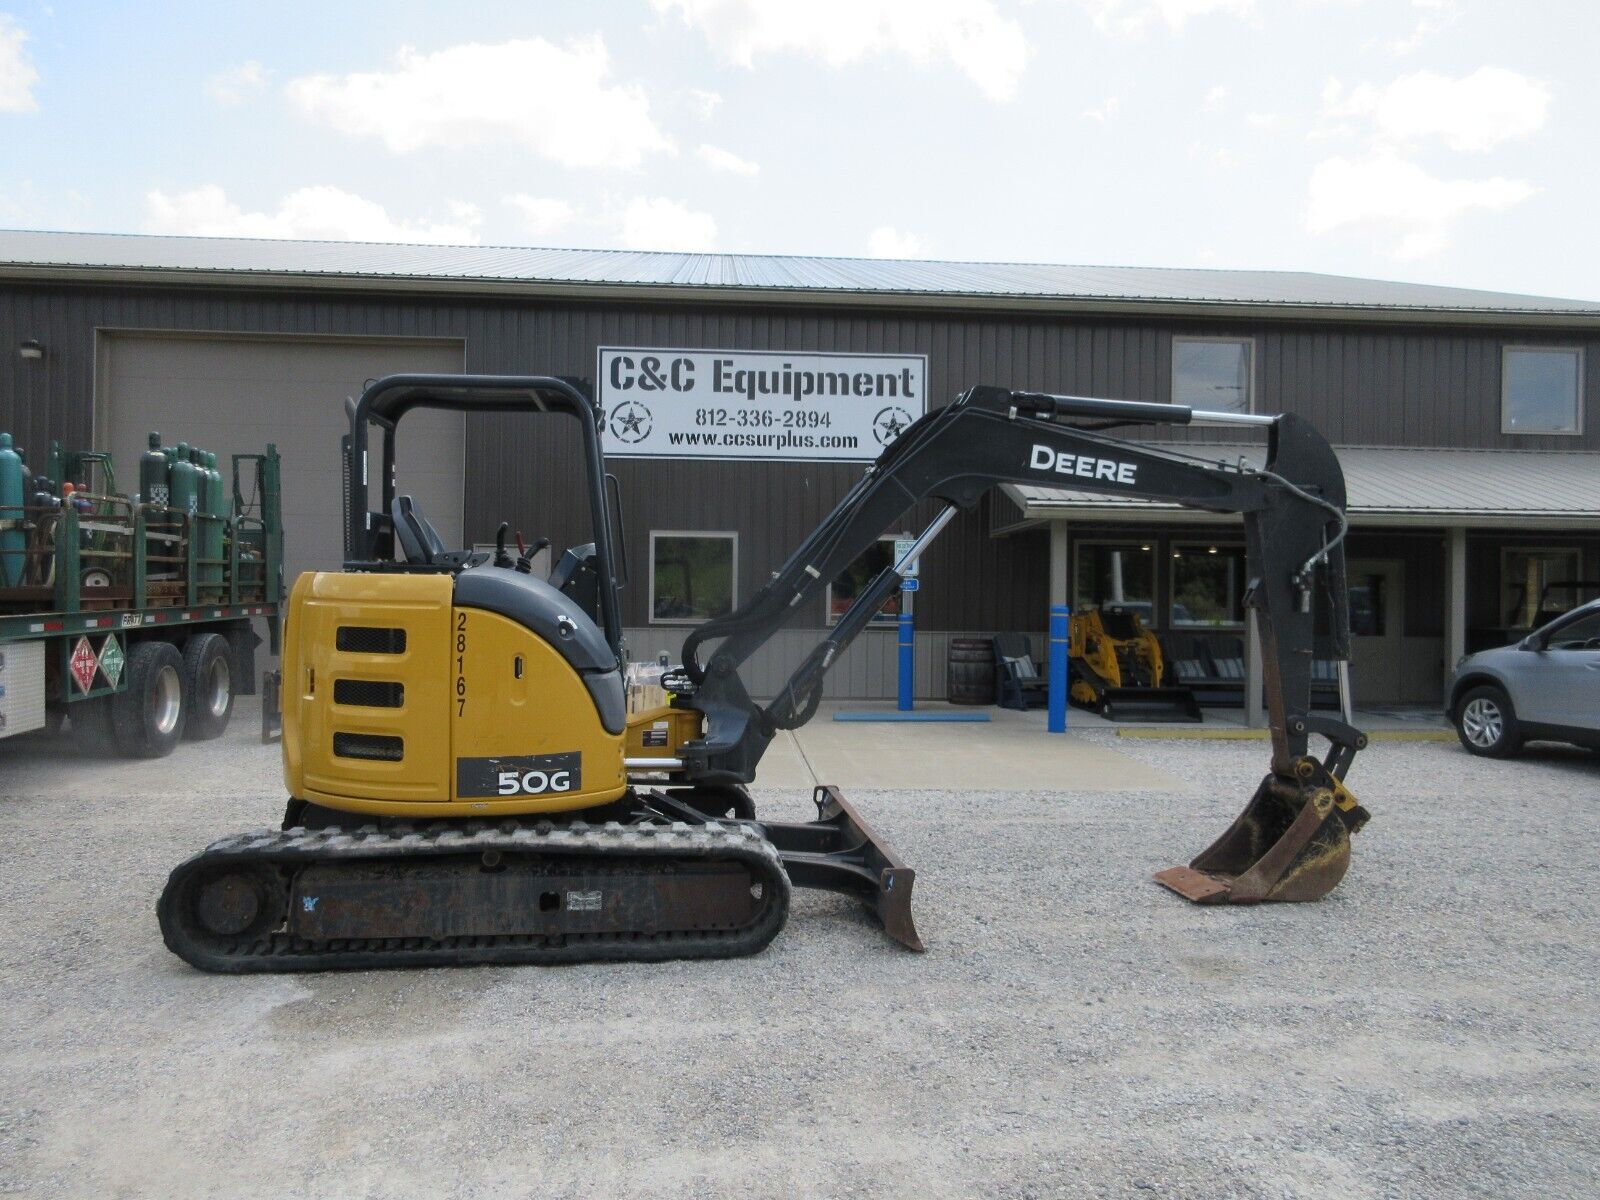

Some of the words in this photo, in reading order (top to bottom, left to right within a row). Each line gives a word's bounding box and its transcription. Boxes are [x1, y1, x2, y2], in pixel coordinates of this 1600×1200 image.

[610, 356, 695, 393] C&C
[713, 359, 915, 401] Equipment
[695, 408, 832, 428] 812-336-2894
[668, 430, 858, 450] www.ccsurplus.com
[1029, 444, 1137, 485] DEERE
[456, 612, 467, 717] 28167
[498, 771, 570, 795] 50G
